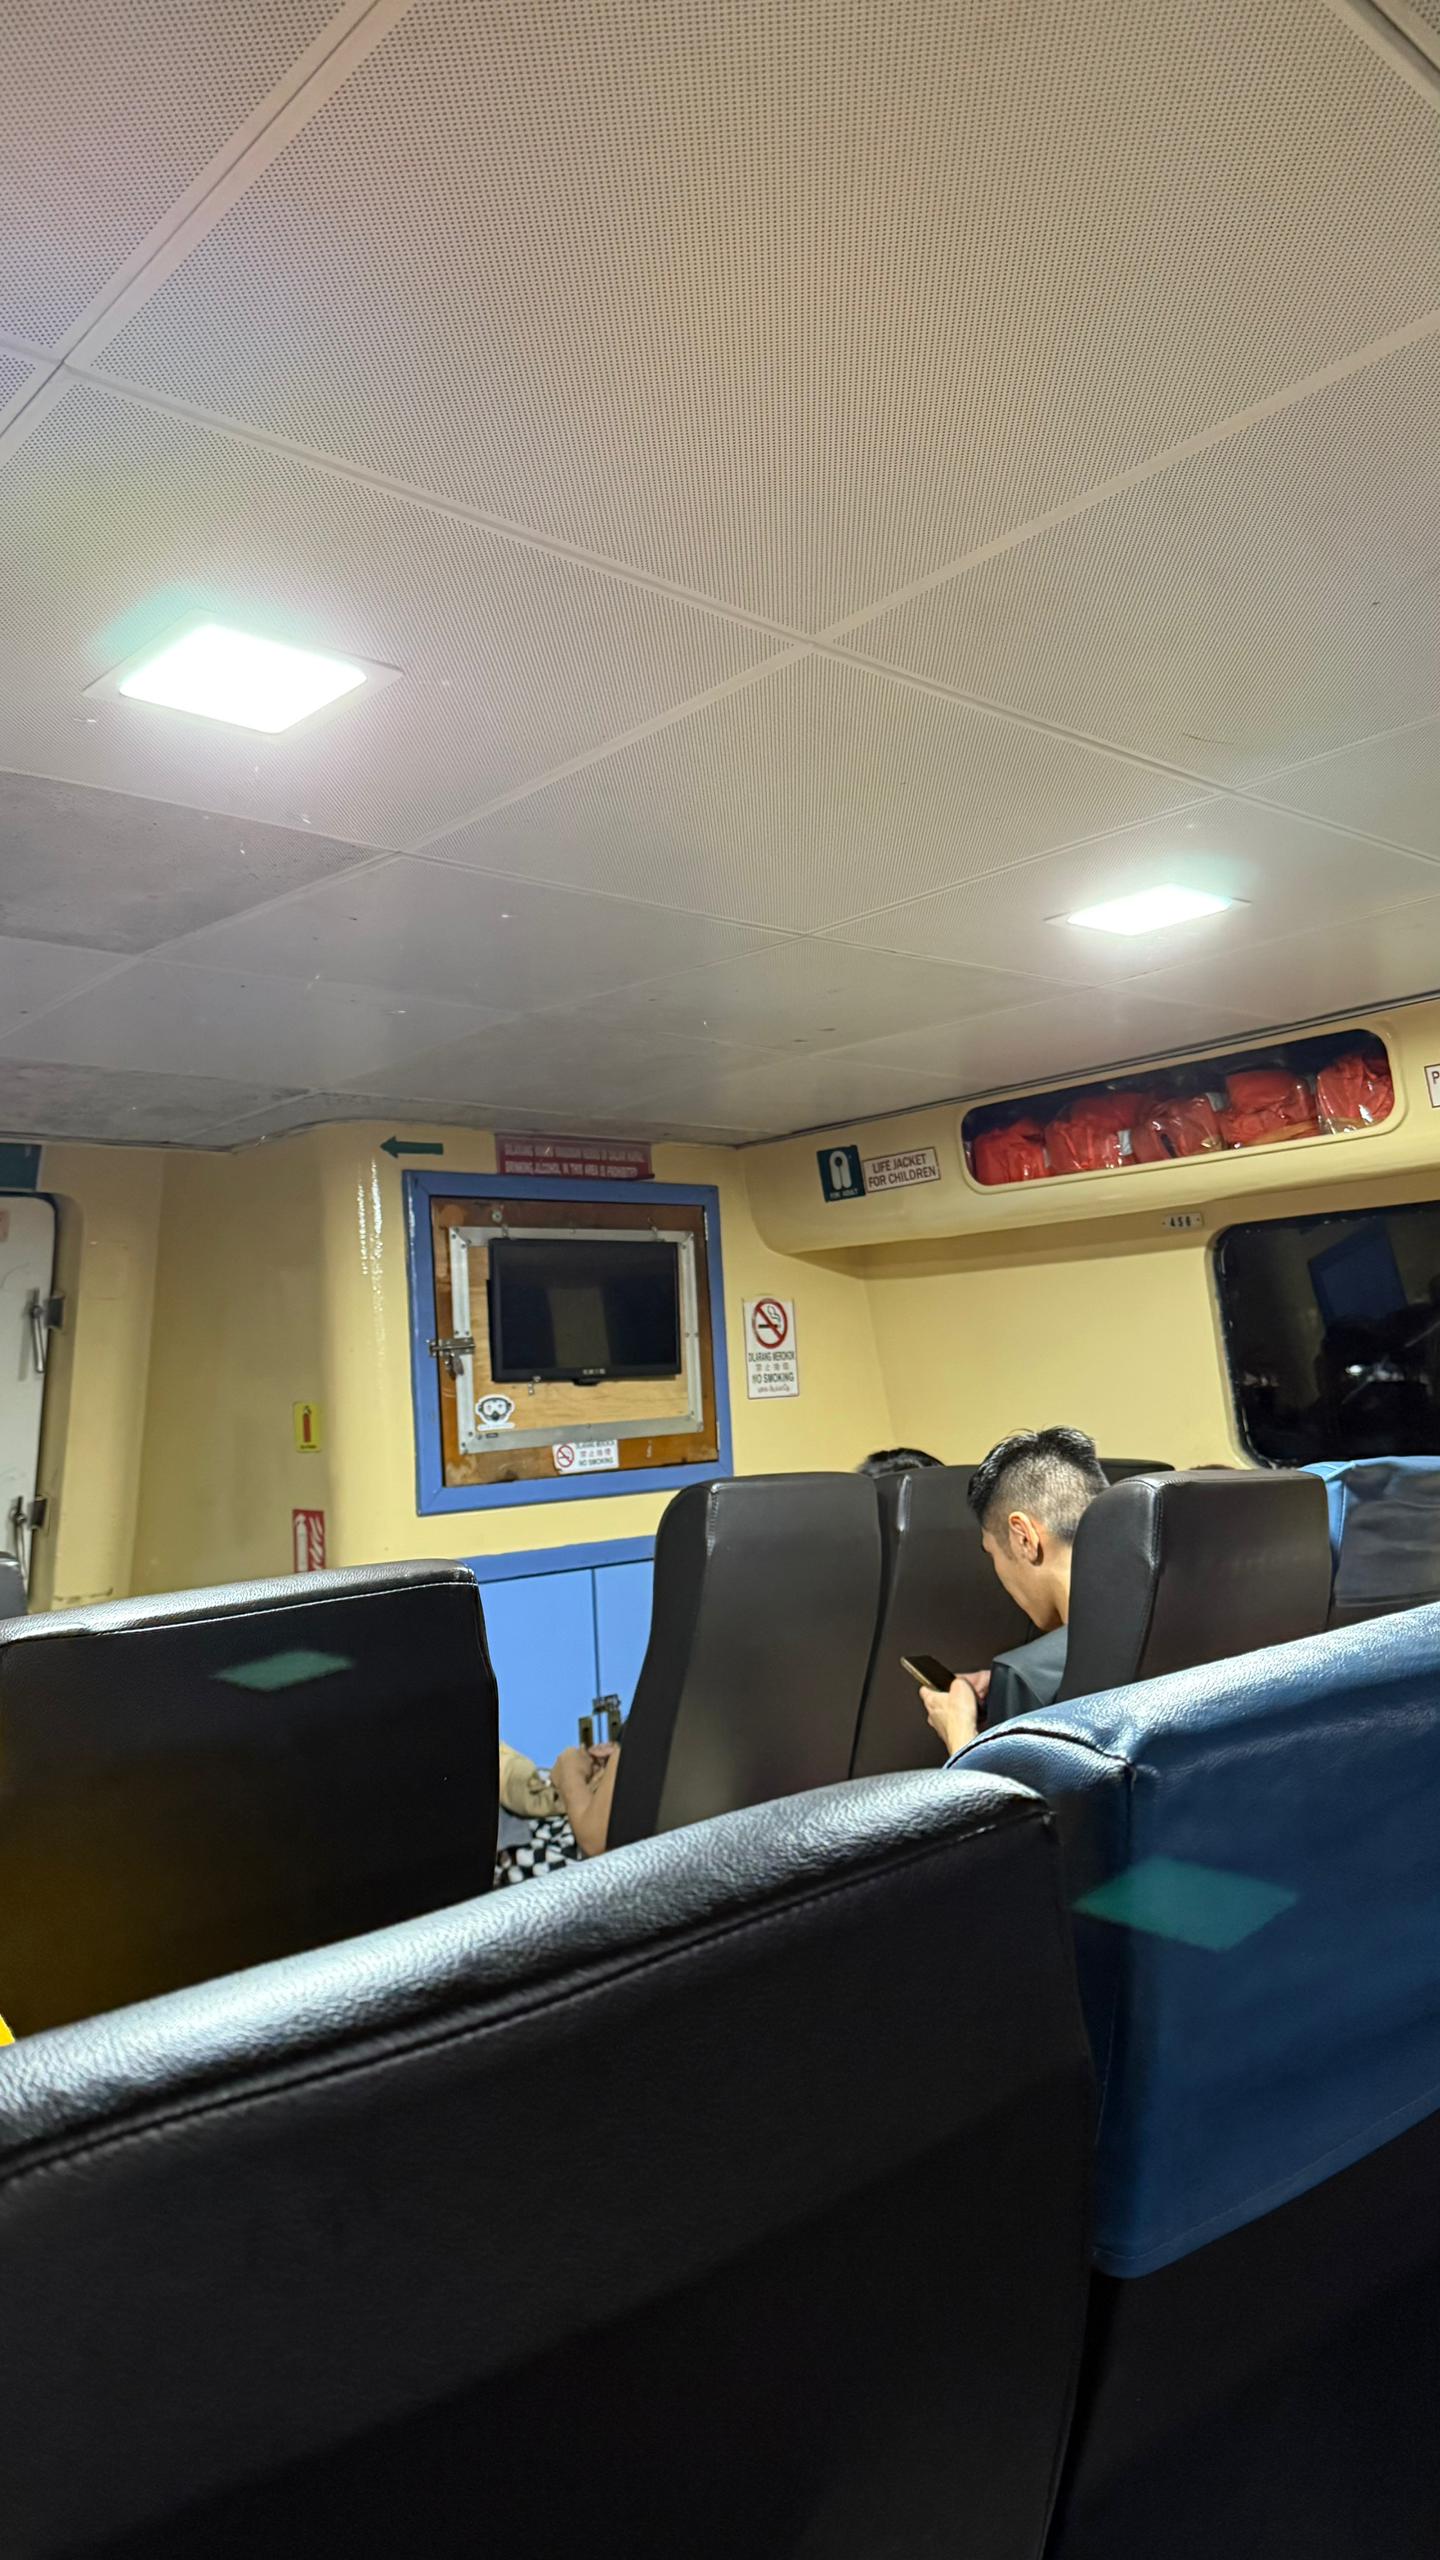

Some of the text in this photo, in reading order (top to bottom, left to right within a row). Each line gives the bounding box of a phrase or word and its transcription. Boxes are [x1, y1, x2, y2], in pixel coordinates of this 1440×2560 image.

[872, 1153, 927, 1174] LIFE JACKET
[868, 1166, 936, 1188] FOR CHILDREN
[752, 1372, 794, 1384] NO SMOKING
